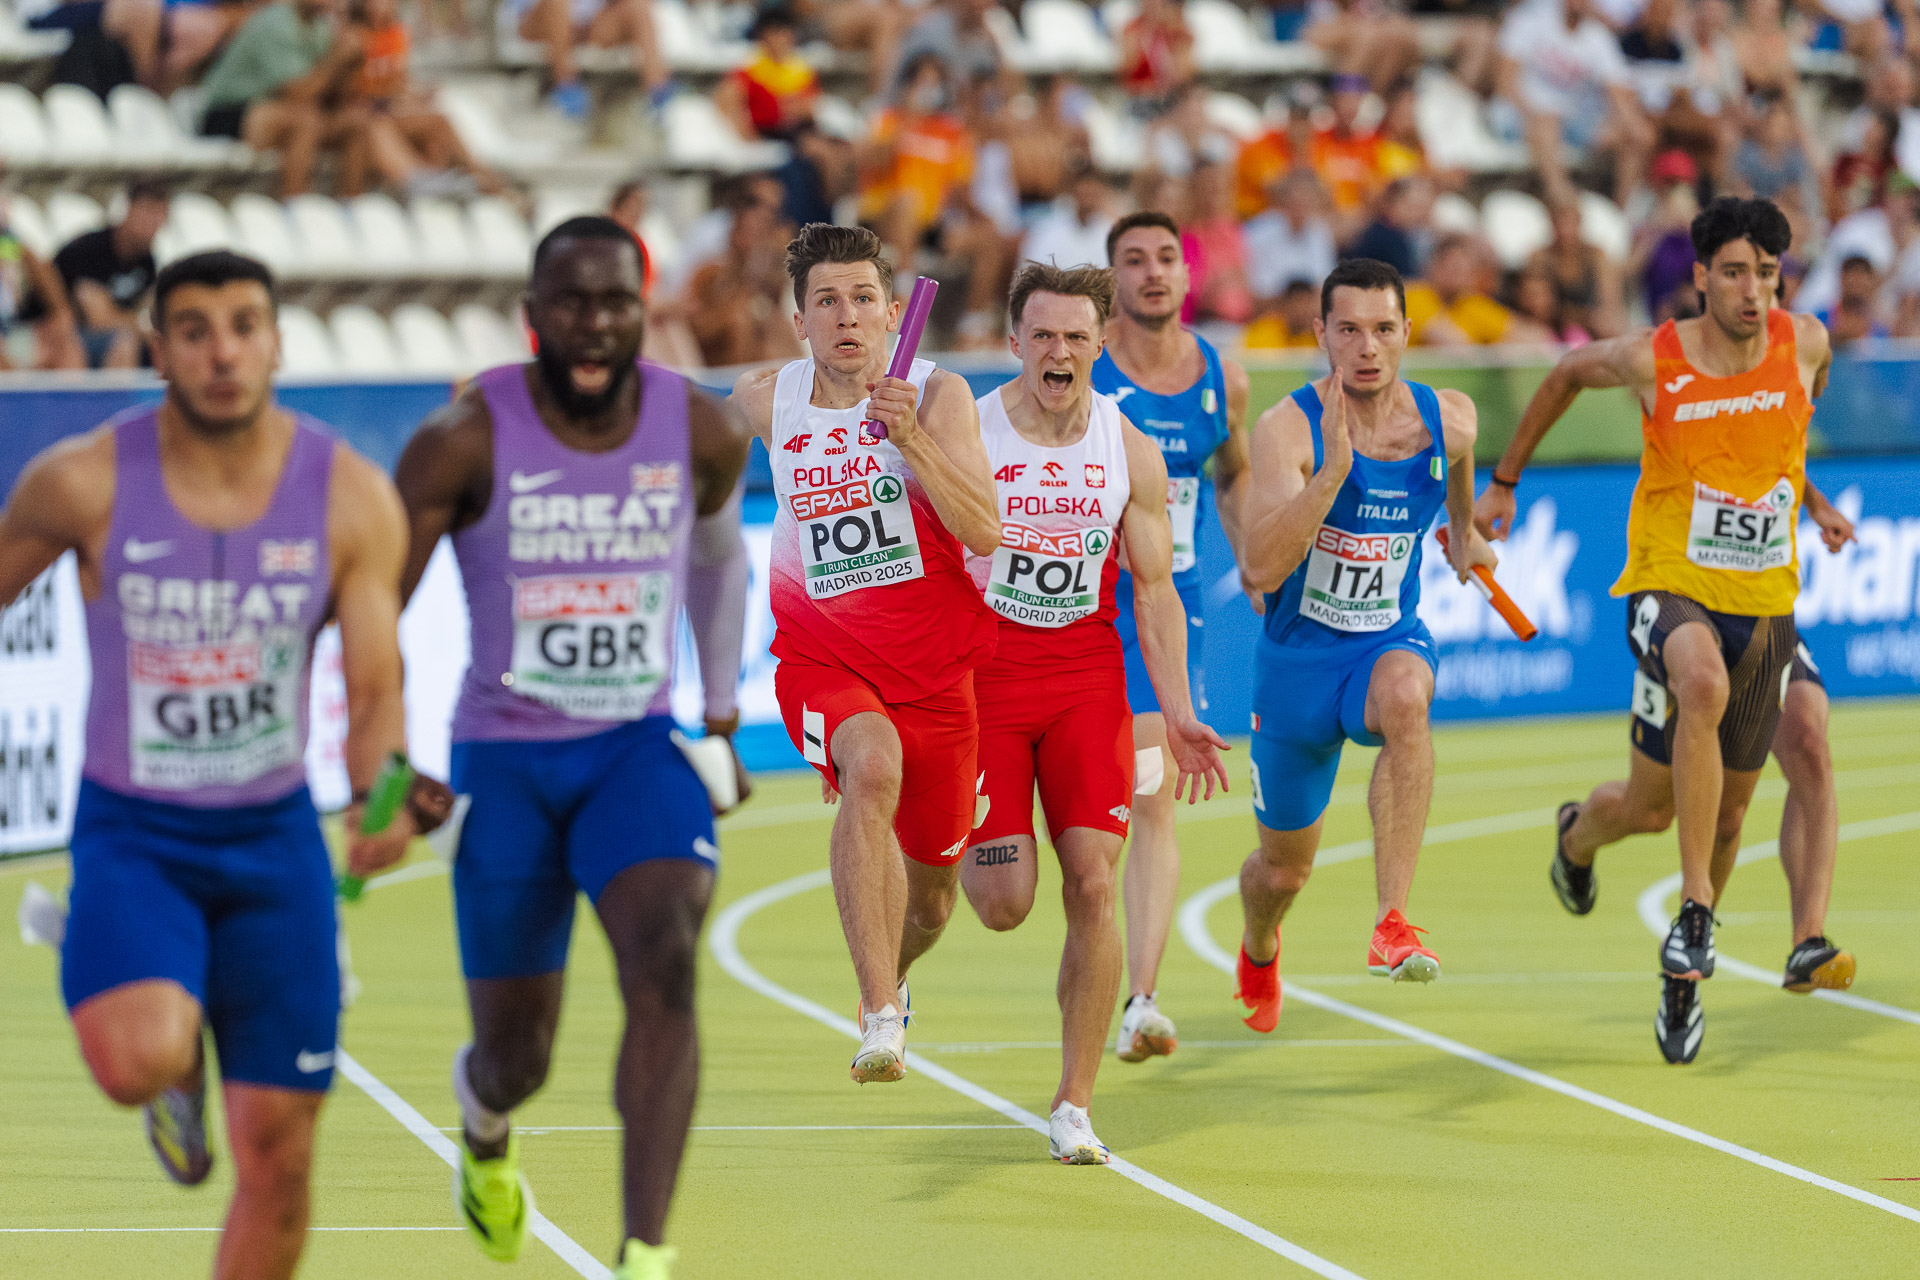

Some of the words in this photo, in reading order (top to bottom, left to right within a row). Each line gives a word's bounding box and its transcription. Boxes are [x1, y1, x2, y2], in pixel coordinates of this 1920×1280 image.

[1673, 390, 1786, 422] ESPAÑA
[784, 434, 812, 453] 4F
[794, 455, 881, 488] POLSKA
[994, 464, 1027, 483] 4F
[509, 494, 682, 530] GREAT
[793, 484, 869, 517] SPAR
[1007, 496, 1103, 519] POLSKA
[1356, 504, 1409, 521] ITALIA
[810, 510, 901, 562] POL
[1001, 526, 1081, 555] SPAR
[1317, 530, 1388, 559] SPAR
[814, 571, 873, 594] MADRID
[875, 561, 913, 581] 2025
[828, 561, 849, 573] RUN
[1006, 552, 1088, 595] POL
[1329, 561, 1383, 599] ITA
[993, 599, 1055, 623] MADRID
[1017, 593, 1041, 605] RUN
[1363, 613, 1392, 627] 2025
[540, 622, 648, 668] GBR
[154, 682, 276, 741] GBR
[1643, 688, 1655, 715] 5
[975, 844, 1019, 867] 2002
